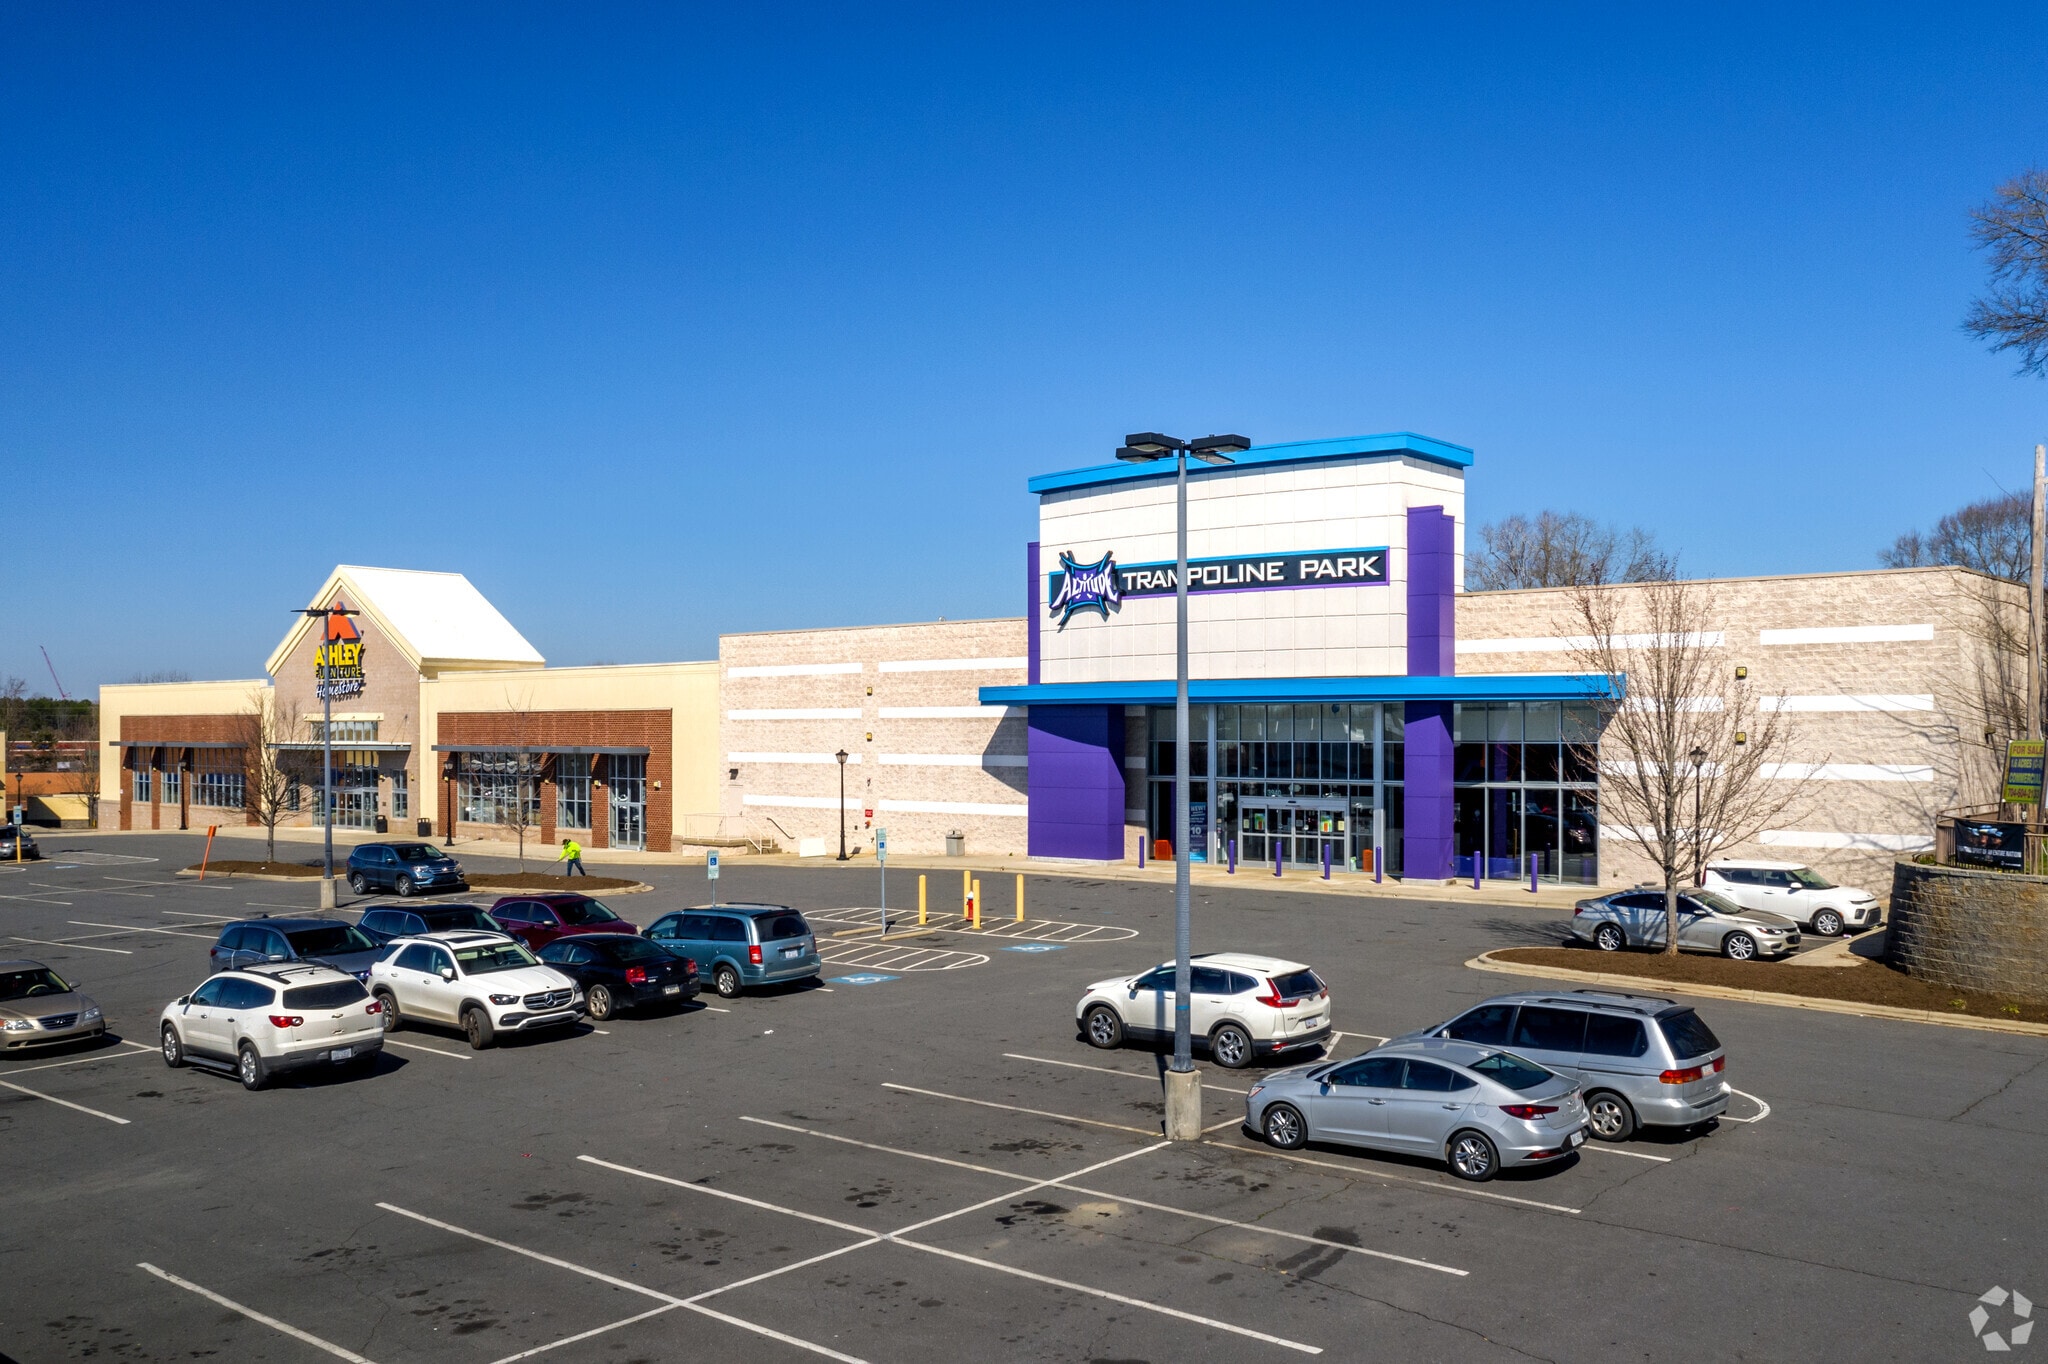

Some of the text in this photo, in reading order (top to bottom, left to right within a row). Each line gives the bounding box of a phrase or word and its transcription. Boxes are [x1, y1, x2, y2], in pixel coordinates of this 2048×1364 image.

[1300, 556, 1381, 579] PARK
[313, 643, 363, 667] AHLEY
[314, 666, 361, 679] FUNITURE
[2012, 745, 2044, 755] FOR SALE
